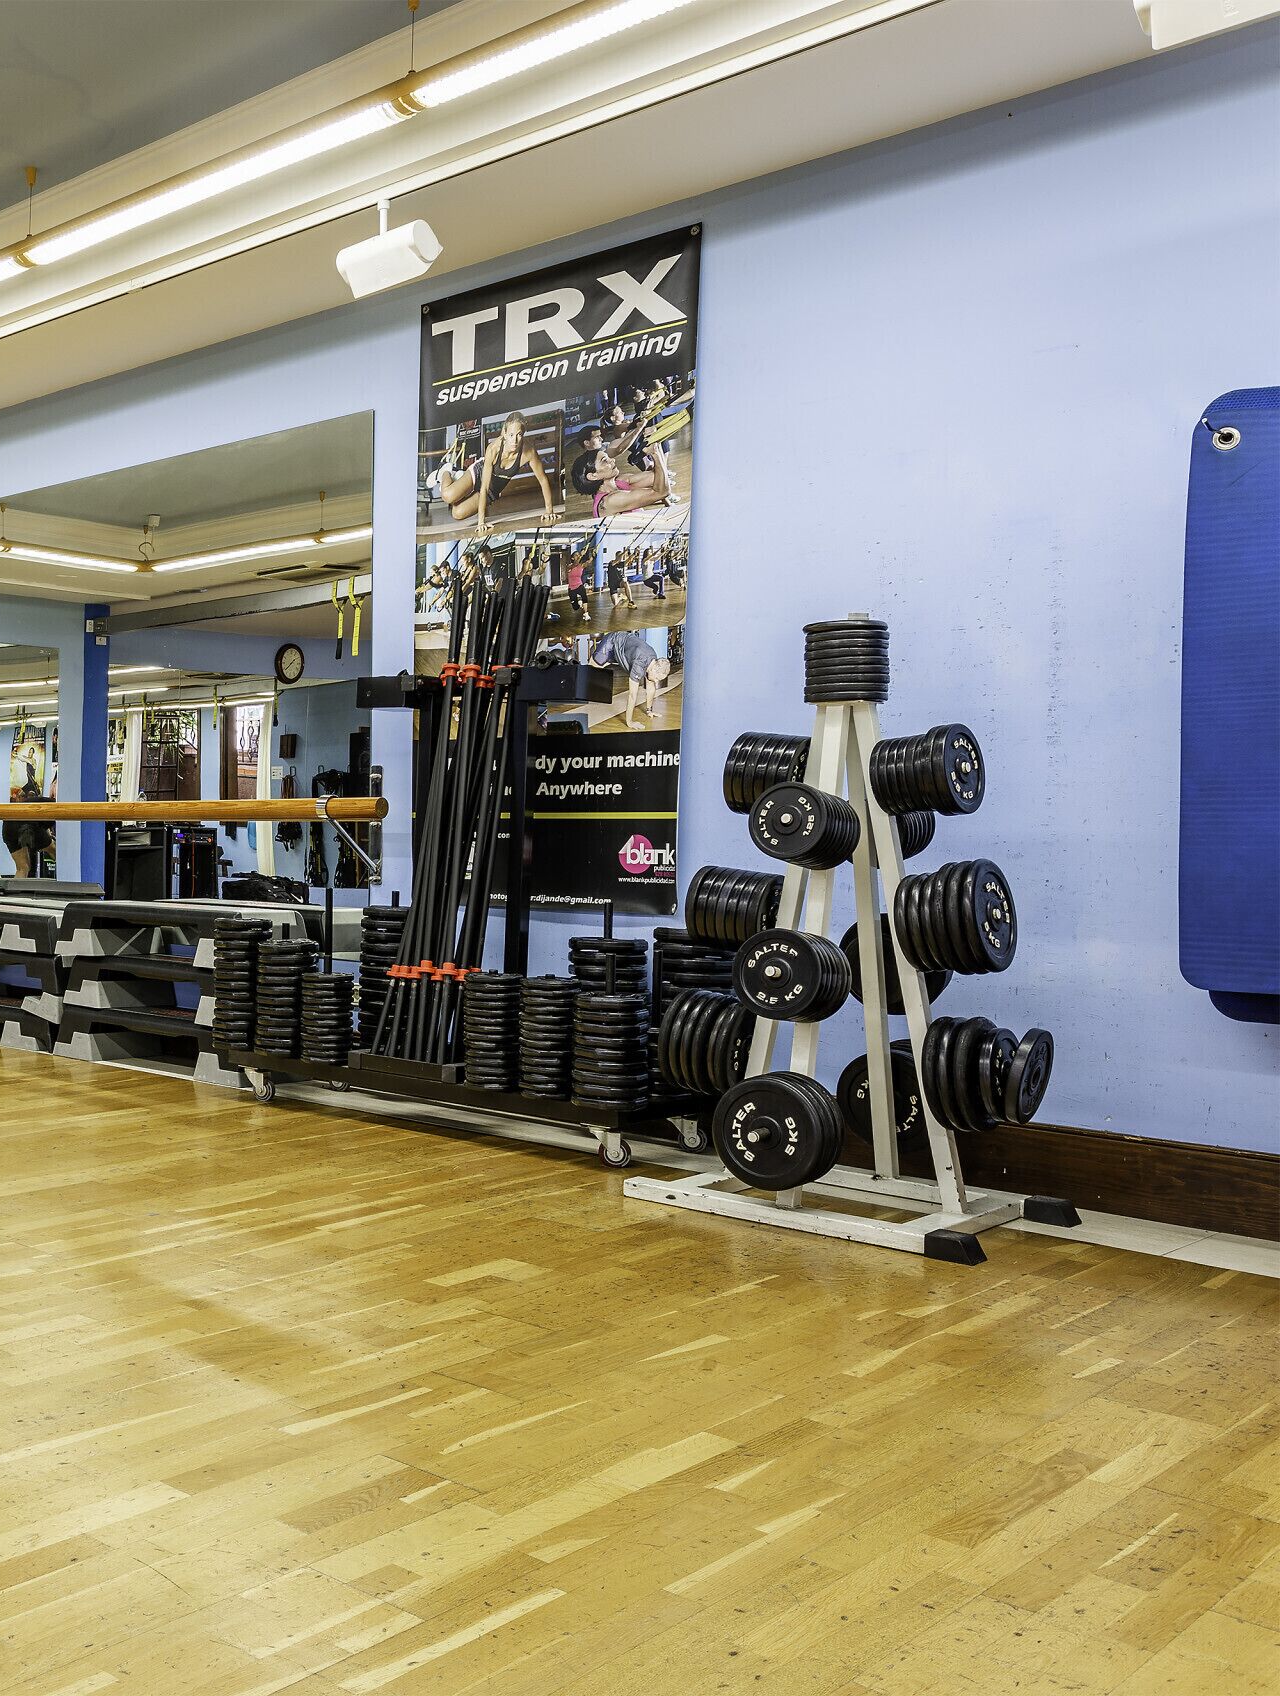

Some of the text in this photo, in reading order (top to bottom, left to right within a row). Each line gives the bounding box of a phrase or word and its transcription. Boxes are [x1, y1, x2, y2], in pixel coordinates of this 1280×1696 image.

[432, 253, 687, 376] TRX
[436, 331, 682, 406] suspension training
[535, 750, 681, 774] dy your machine
[953, 738, 979, 770] SALTER
[536, 781, 623, 800] Anywhere
[798, 796, 812, 811] KG
[758, 800, 779, 846] SALTER
[626, 842, 675, 865] blank
[985, 881, 1010, 924] SALTER
[748, 943, 799, 969] SALTER
[756, 984, 803, 1005] 2.5 KG
[896, 1095, 919, 1133] SALT
[732, 1102, 756, 1162] SALTER
